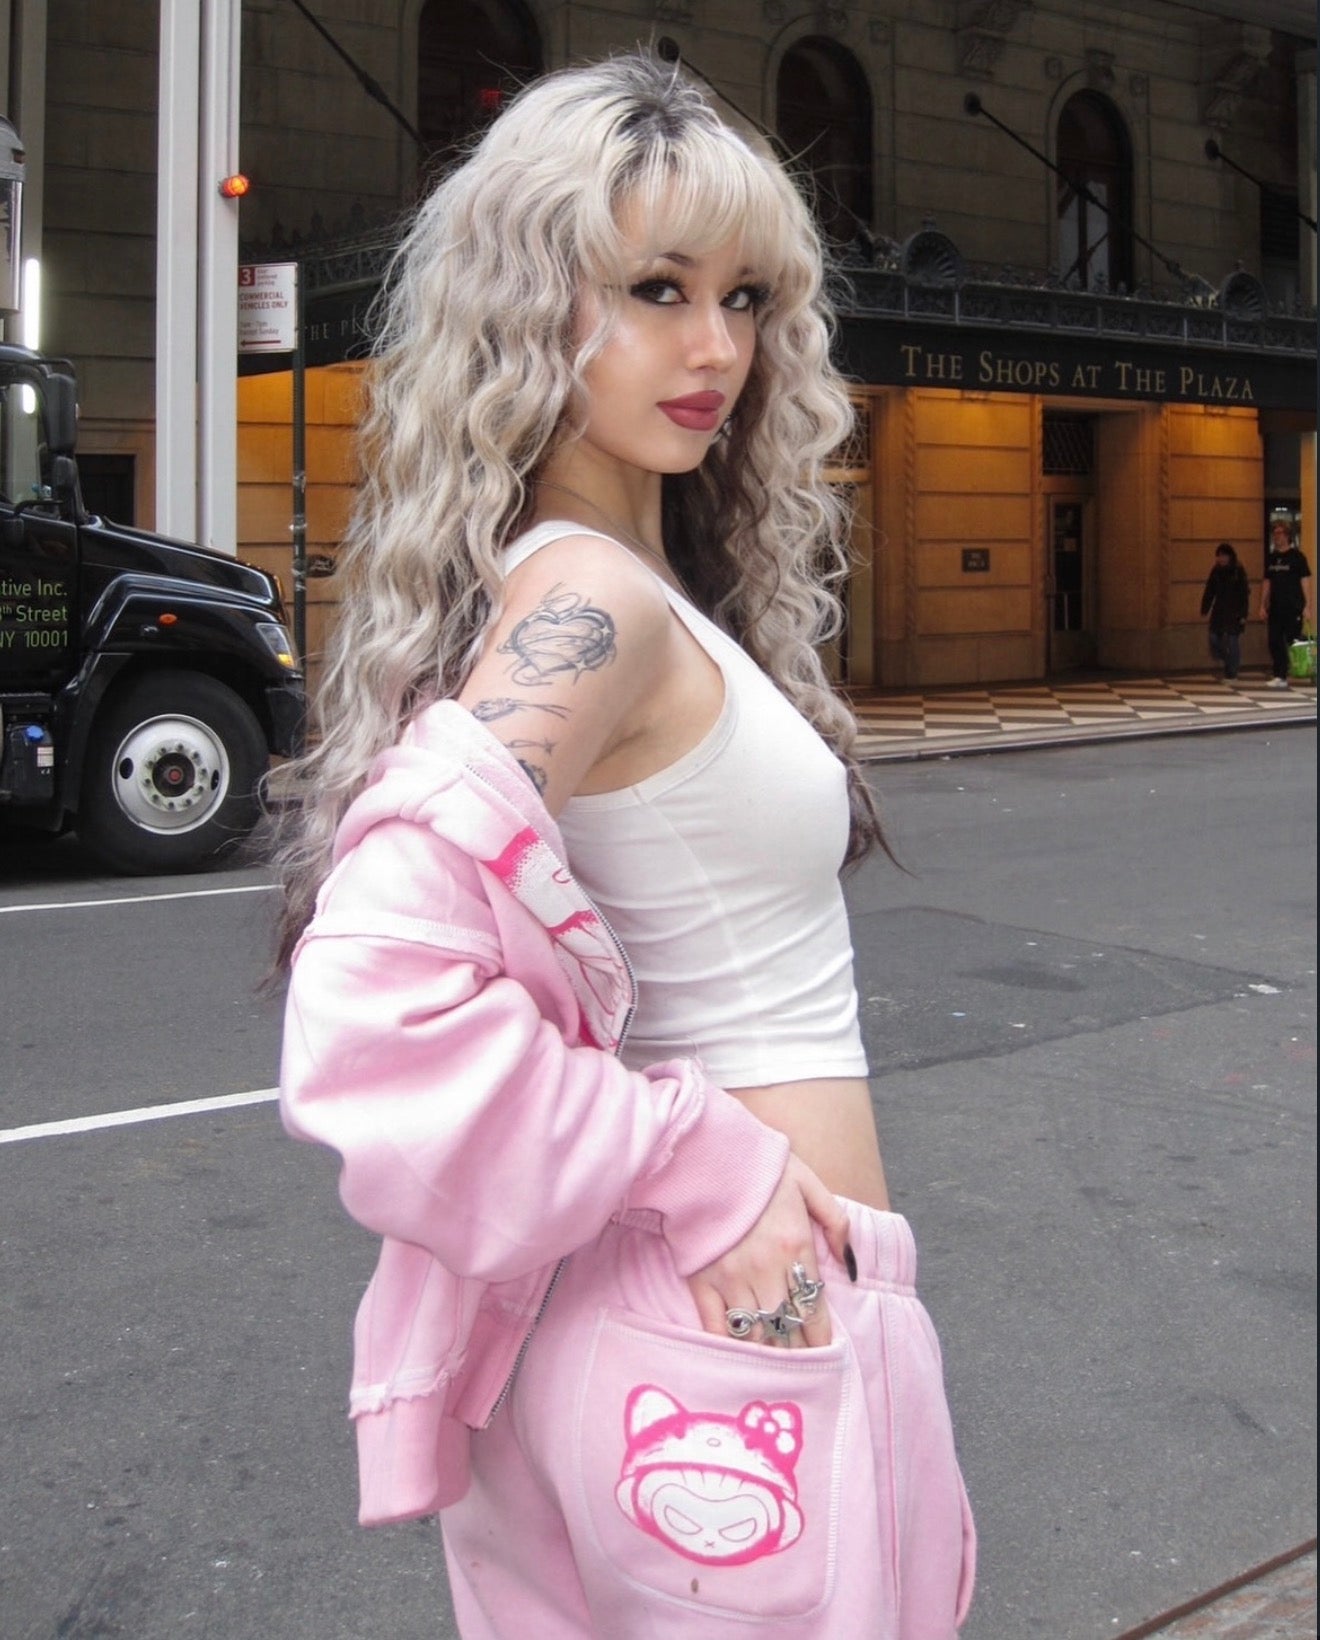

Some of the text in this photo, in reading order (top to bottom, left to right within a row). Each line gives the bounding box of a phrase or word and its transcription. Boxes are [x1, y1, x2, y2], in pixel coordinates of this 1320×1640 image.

[242, 268, 251, 285] 3
[240, 291, 284, 301] COMMERCIAL
[240, 300, 288, 310] VEHICLES ONLY
[0, 578, 67, 596] tive Inc.
[16, 604, 67, 622] Street
[24, 630, 68, 647] 10001
